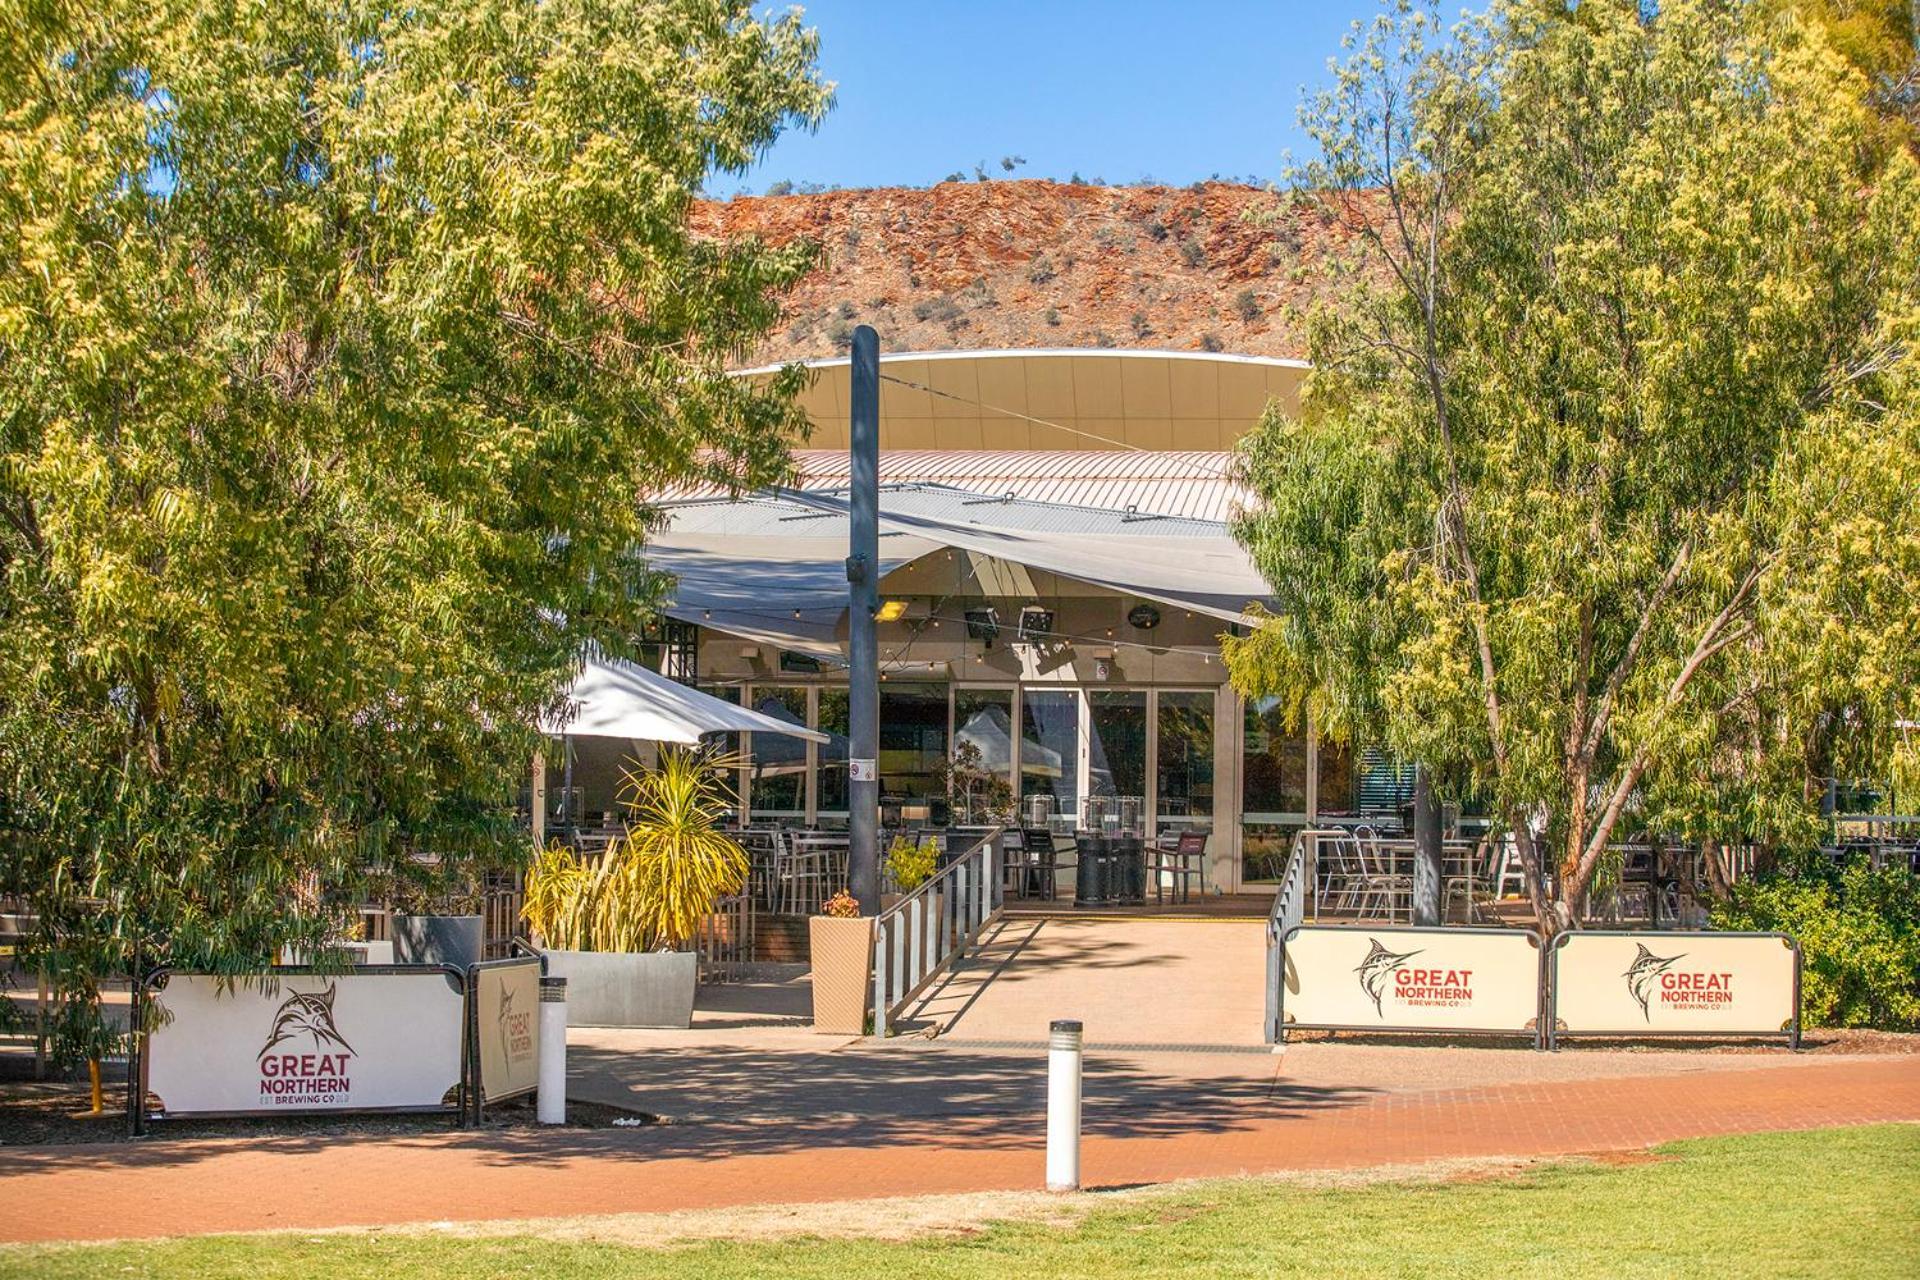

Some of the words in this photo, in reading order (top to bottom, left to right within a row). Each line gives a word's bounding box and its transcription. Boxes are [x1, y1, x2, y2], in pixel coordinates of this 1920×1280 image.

[1395, 968, 1473, 987] GREAT
[1661, 972, 1733, 990] GREAT
[1395, 986, 1473, 1000] NORTHERN
[1661, 991, 1733, 1003] NORTHERN
[1407, 999, 1447, 1007] BREWING
[509, 1012, 530, 1036] GREAT
[260, 1054, 351, 1077] GREAT
[260, 1078, 350, 1095] NORTHERN
[275, 1095, 320, 1105] BREWING
